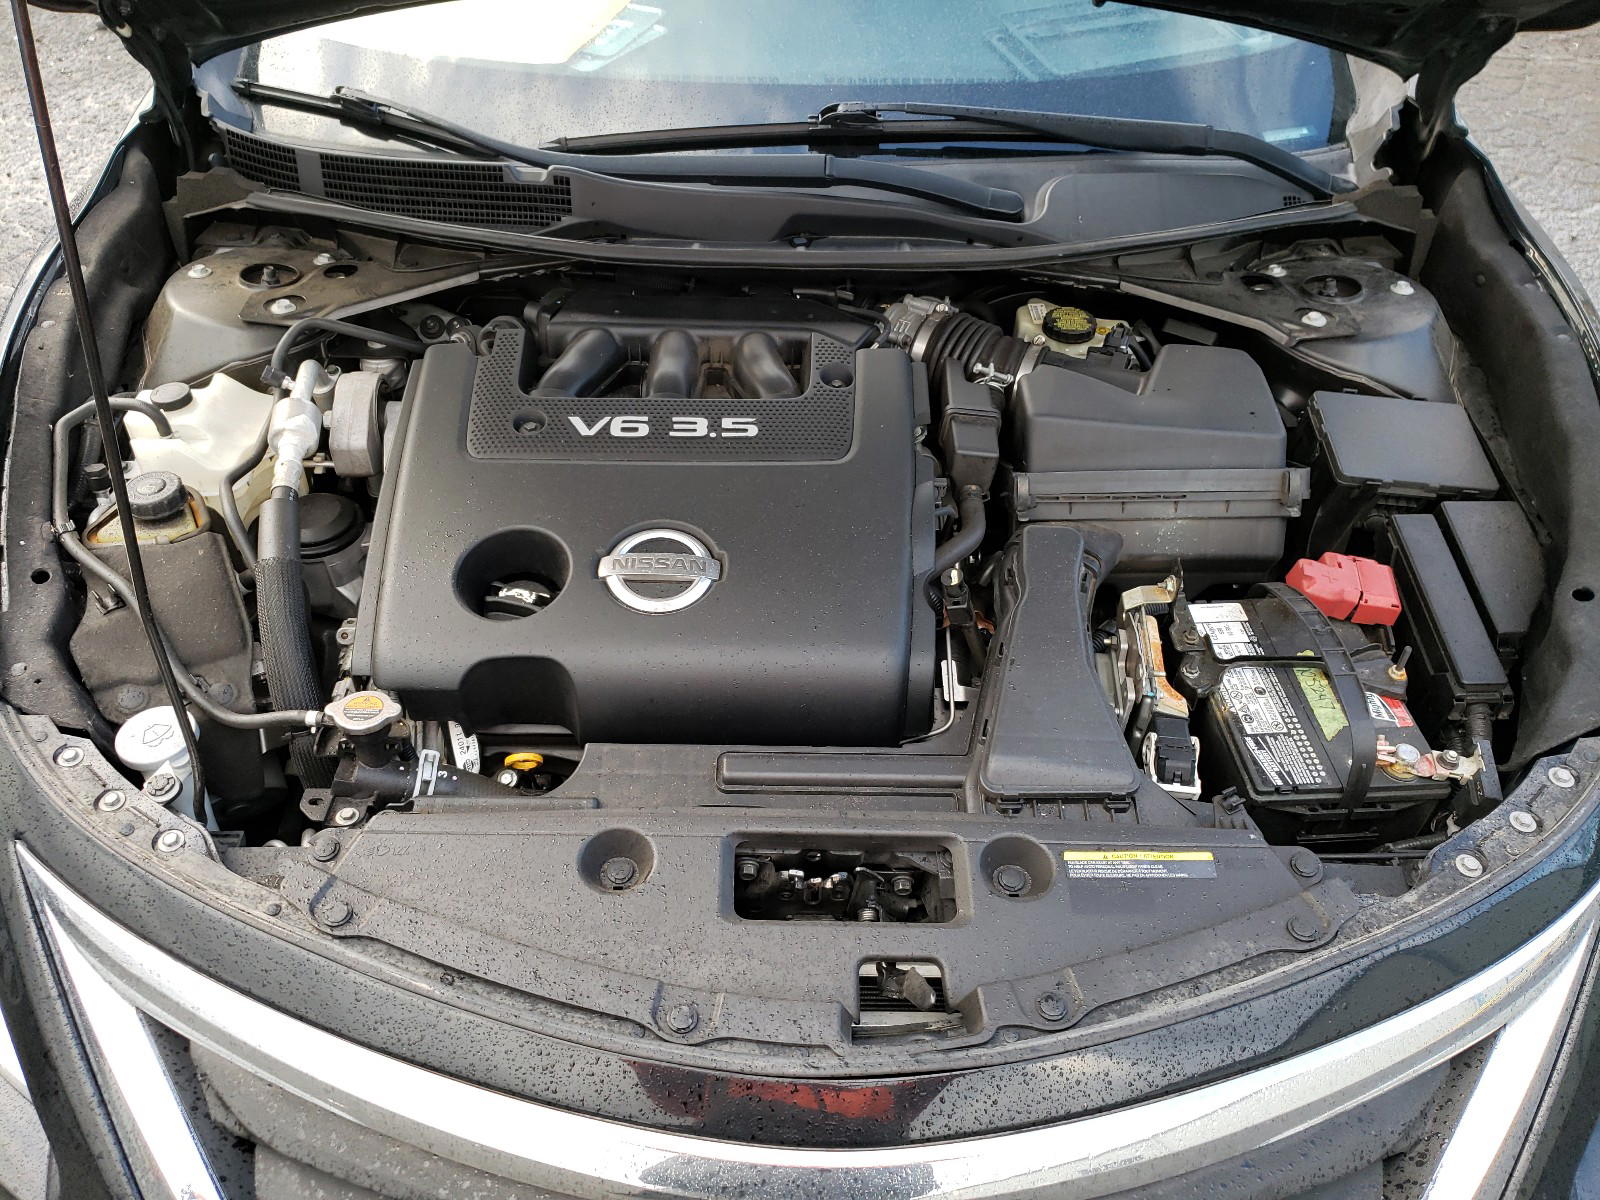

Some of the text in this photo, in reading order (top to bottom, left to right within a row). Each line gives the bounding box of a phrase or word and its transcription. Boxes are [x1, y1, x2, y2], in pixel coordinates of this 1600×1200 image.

[567, 415, 759, 438] V6 3.5
[611, 555, 707, 573] NISSAN
[456, 732, 466, 756] 24011
[1243, 736, 1284, 785] MAINTENANCE-FREE
[1261, 749, 1280, 771] BATTERY
